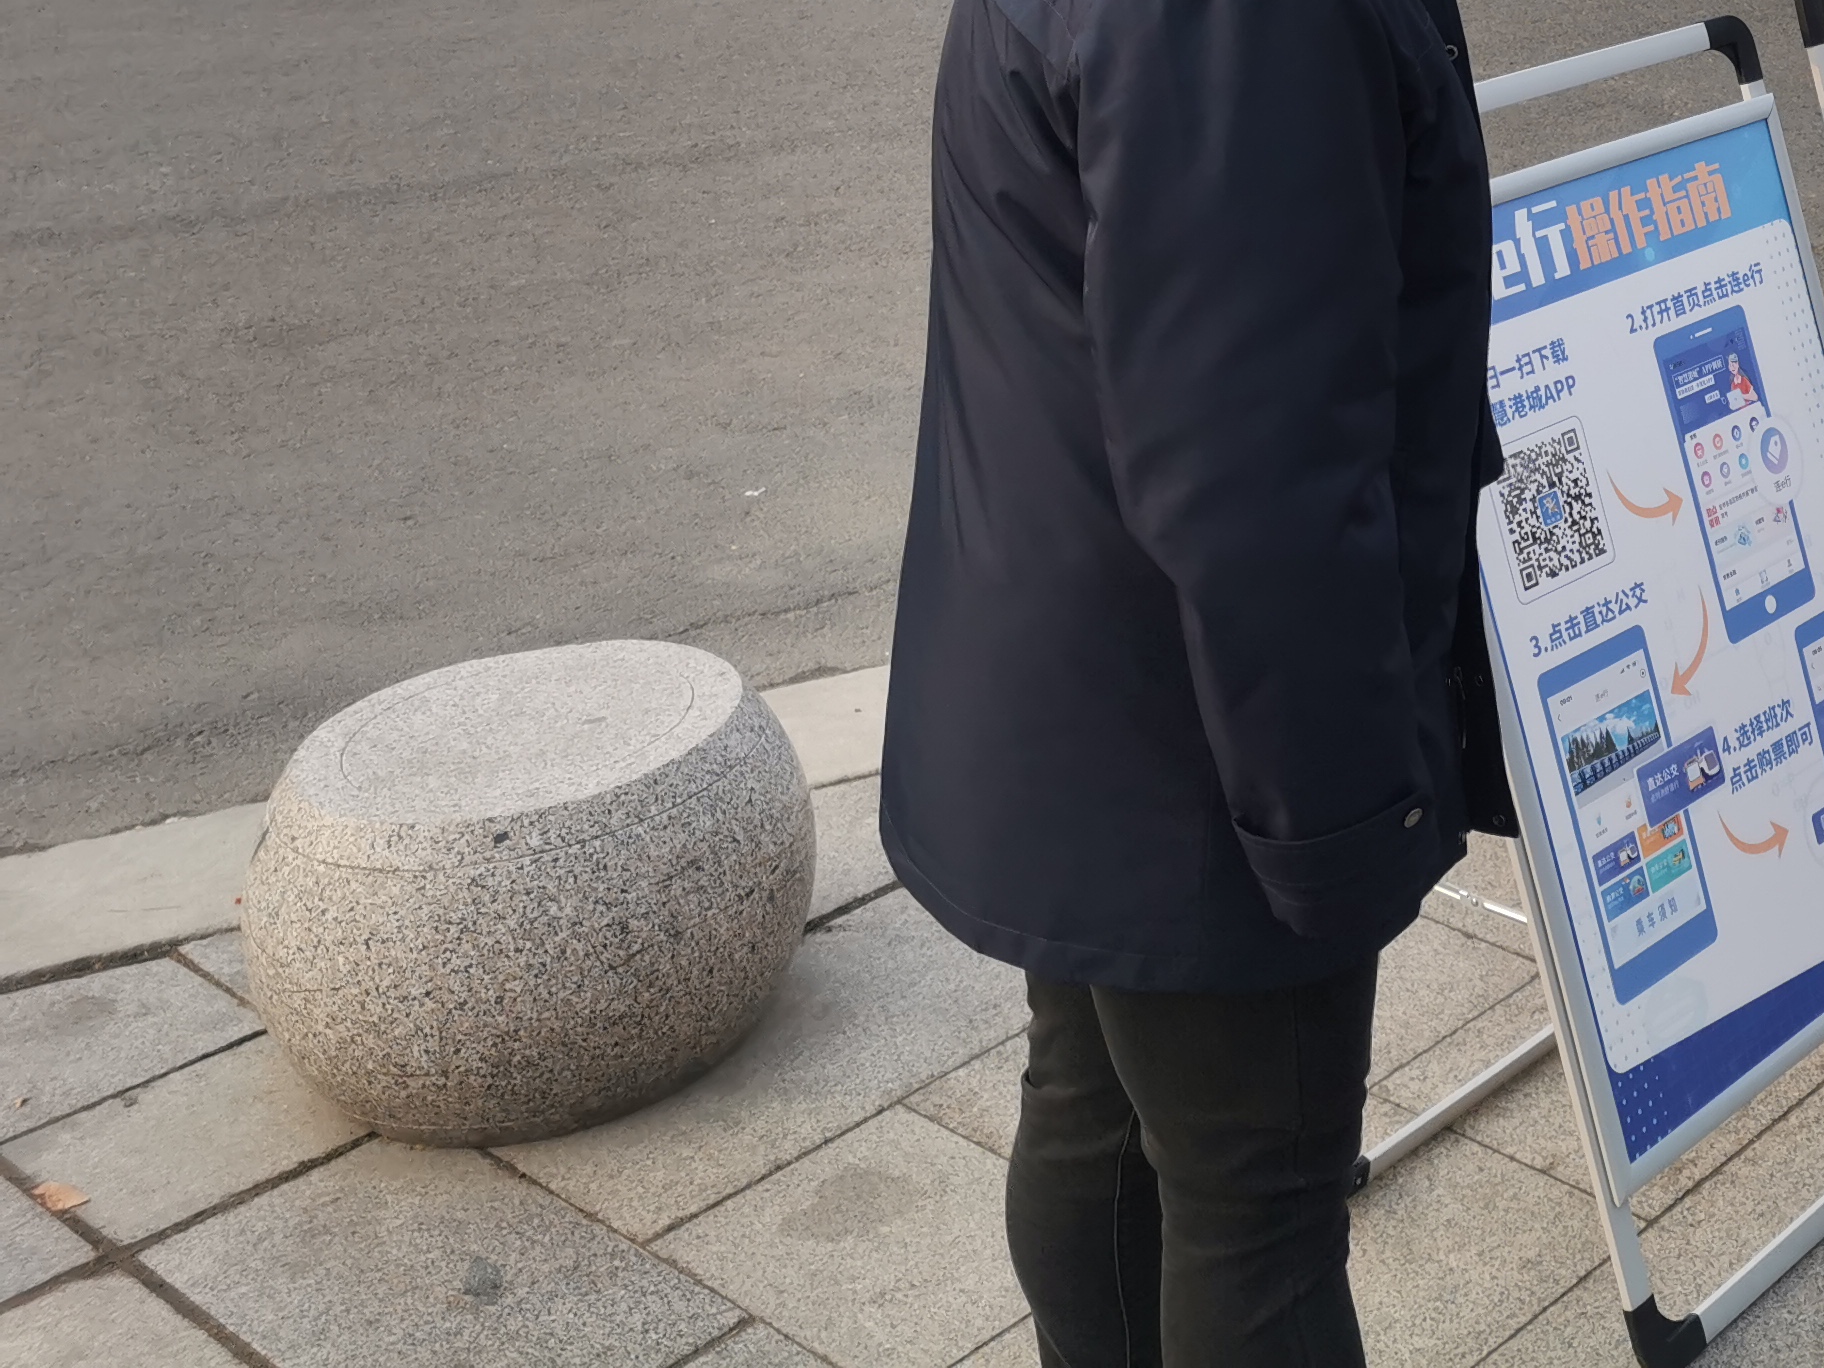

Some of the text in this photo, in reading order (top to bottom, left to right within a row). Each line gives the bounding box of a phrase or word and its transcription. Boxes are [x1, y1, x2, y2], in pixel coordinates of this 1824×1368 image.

[1625, 262, 1764, 335] 2.打开首页点击连e行
[1529, 581, 1649, 658] 3.点击直达公交
[1721, 698, 1795, 757] 4.选择班次
[1729, 722, 1814, 795] 点击购票即可
[1646, 763, 1680, 792] 直达公交
